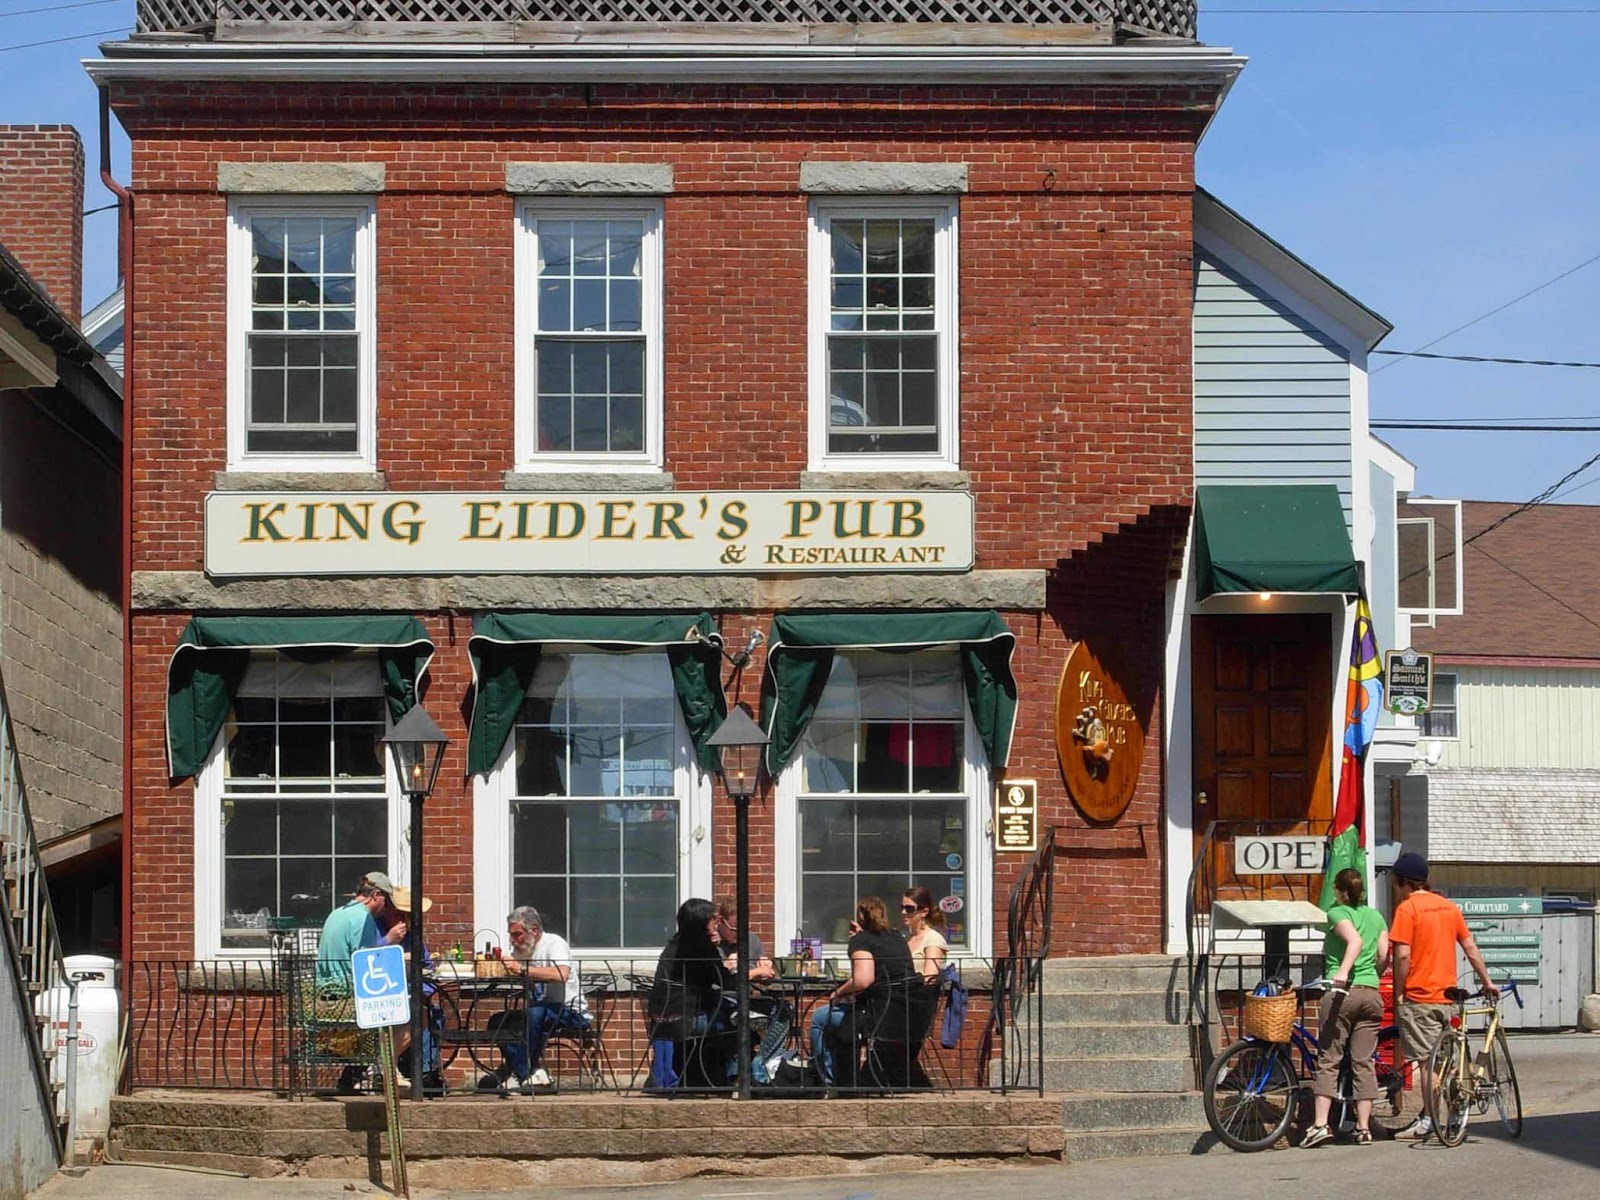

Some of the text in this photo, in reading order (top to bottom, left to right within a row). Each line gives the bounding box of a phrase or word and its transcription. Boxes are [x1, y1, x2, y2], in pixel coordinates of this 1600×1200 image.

[239, 495, 928, 545] KING EIDER'S PUB
[719, 544, 945, 565] & RESTAURANT
[1464, 901, 1509, 912] COURTYARD
[362, 998, 402, 1011] PARKING
[371, 1011, 395, 1022] ONLY
